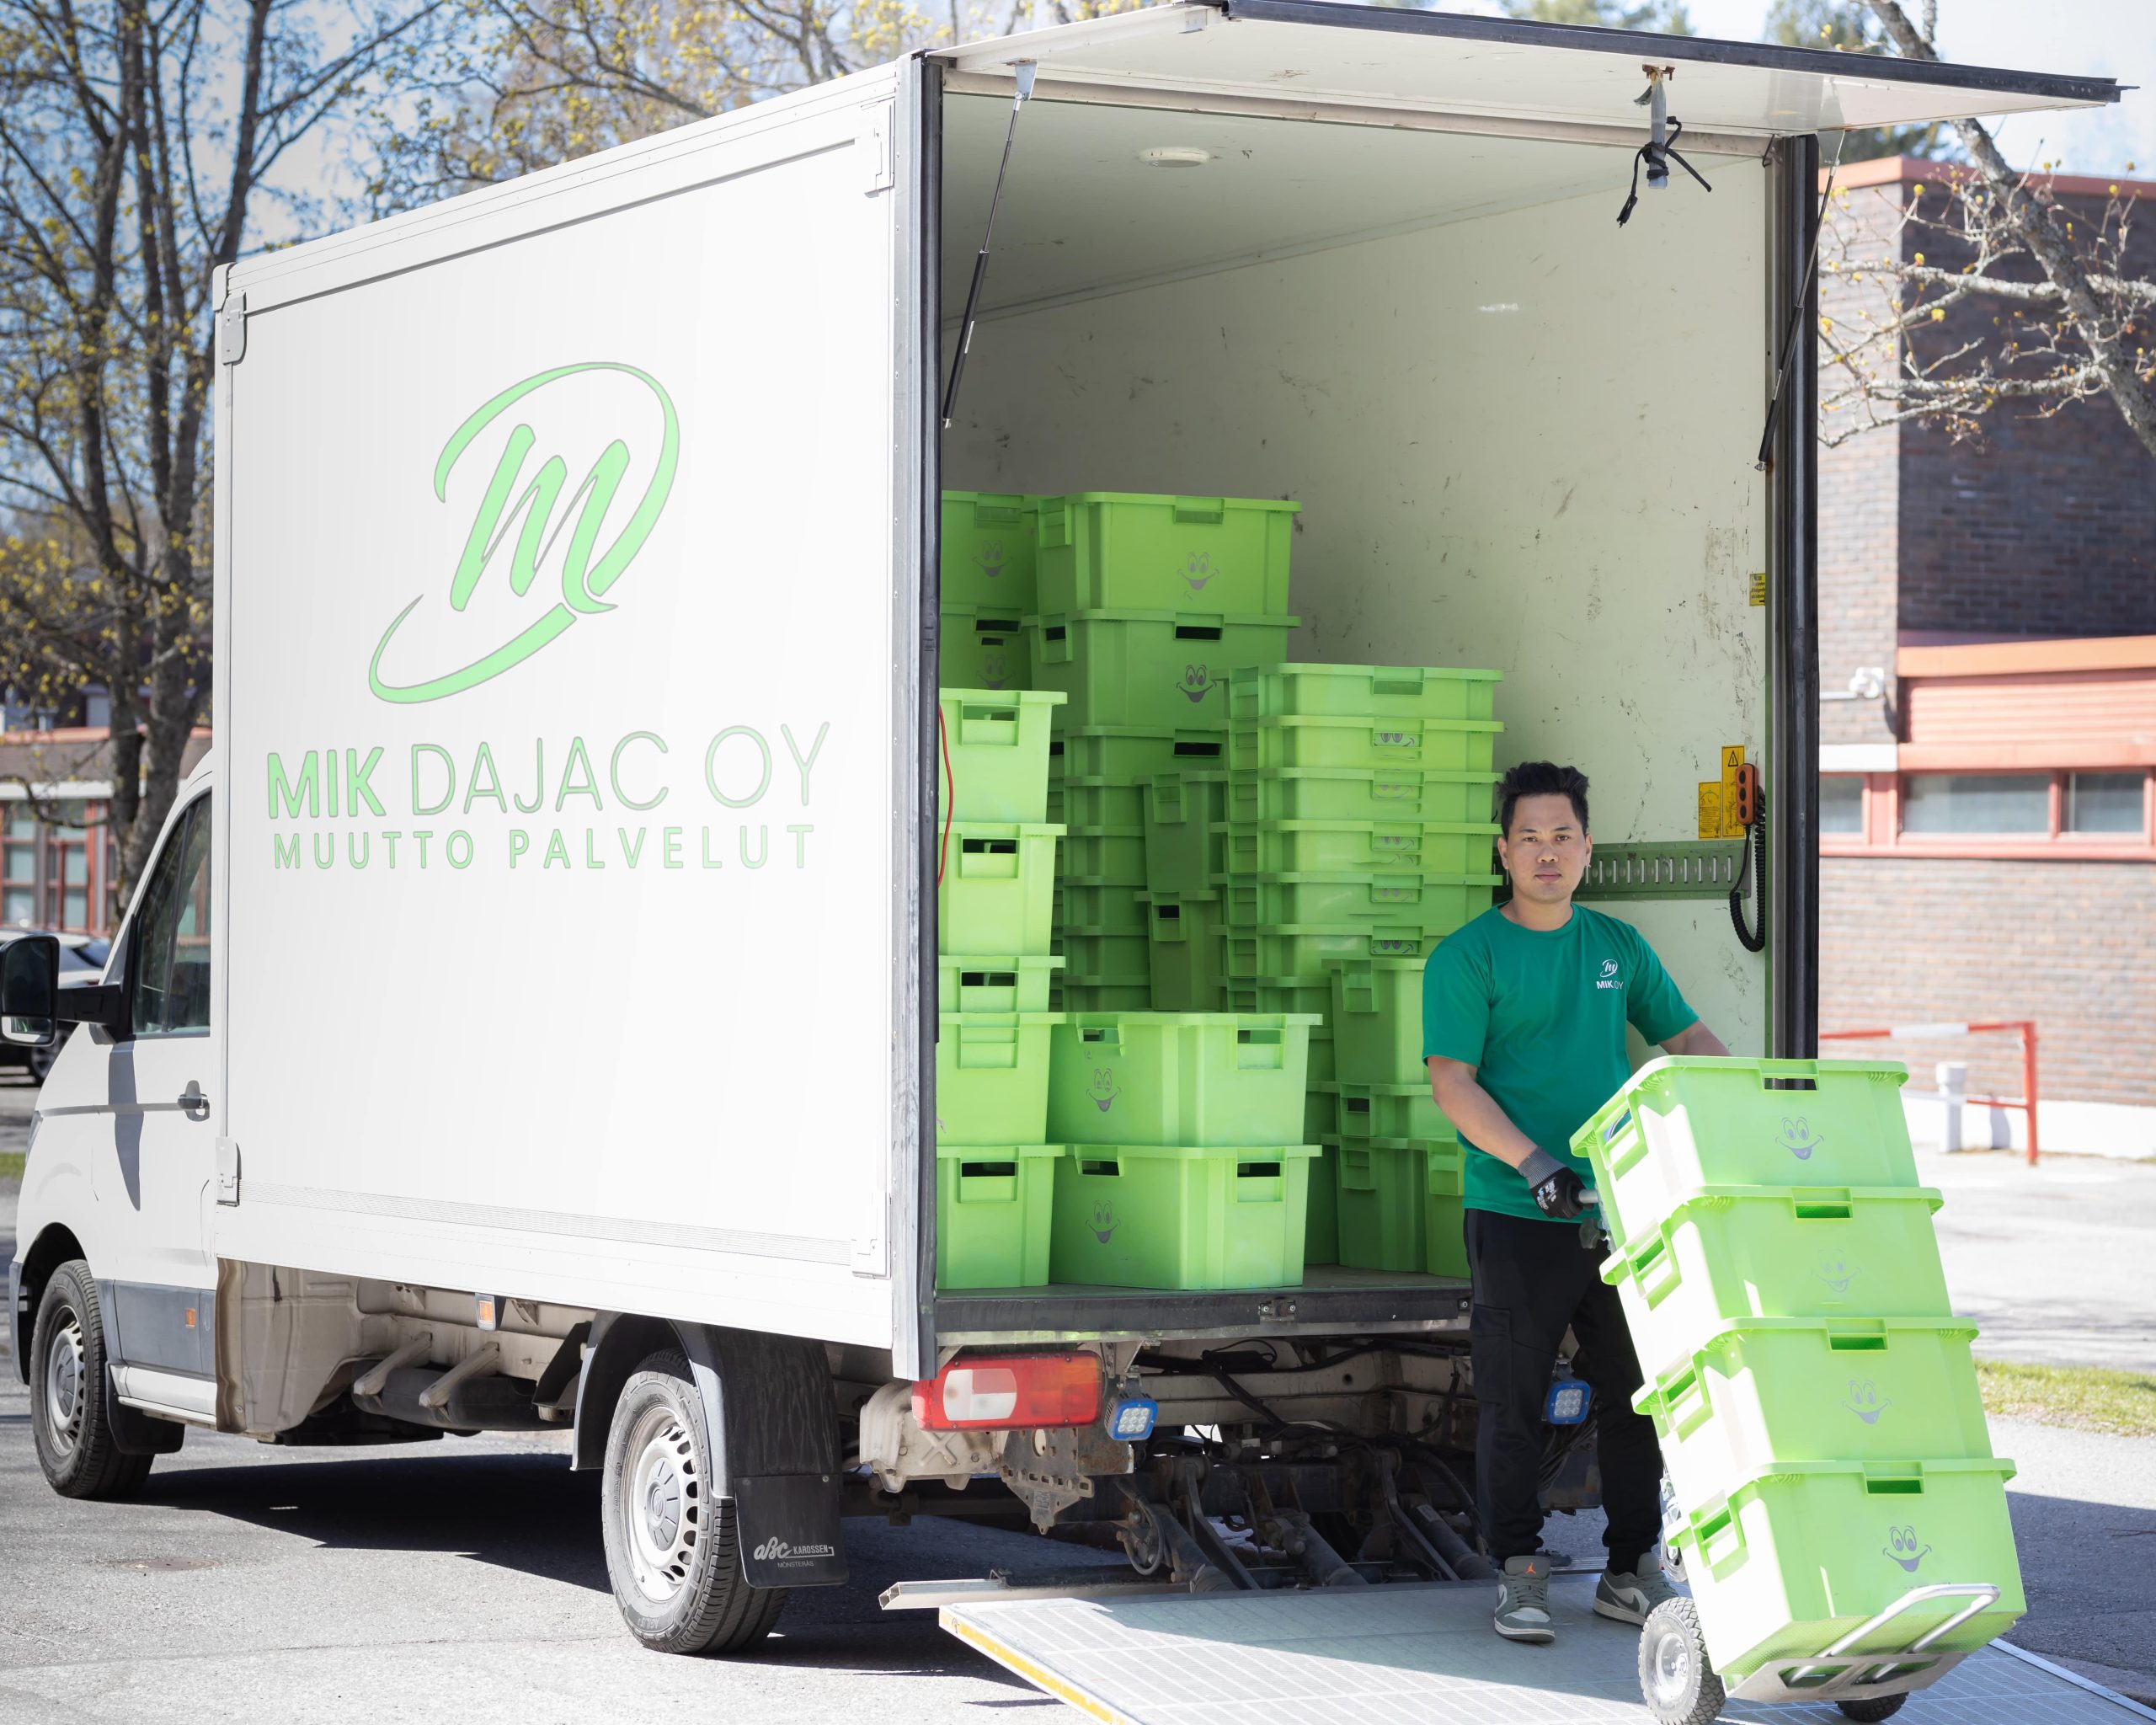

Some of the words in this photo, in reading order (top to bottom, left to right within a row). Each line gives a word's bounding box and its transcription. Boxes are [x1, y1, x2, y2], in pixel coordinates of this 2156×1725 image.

[266, 746, 387, 820] MIK
[410, 729, 670, 816] DAJAC
[704, 721, 830, 809] OY
[274, 830, 474, 870] MUUTTO
[509, 824, 814, 870] PALVELUT
[1596, 980, 1614, 990] MIK
[1614, 980, 1624, 990] OY
[792, 1544, 829, 1555] KAROSSEN
